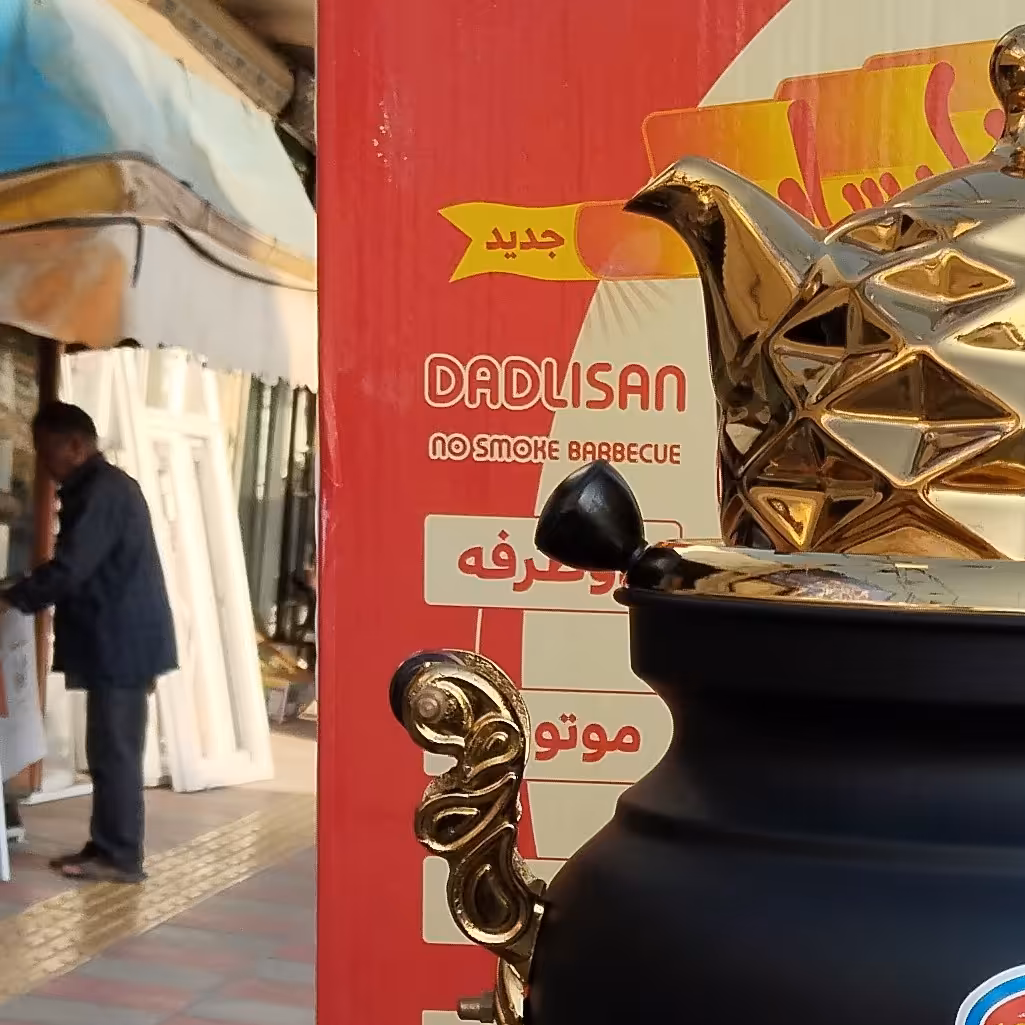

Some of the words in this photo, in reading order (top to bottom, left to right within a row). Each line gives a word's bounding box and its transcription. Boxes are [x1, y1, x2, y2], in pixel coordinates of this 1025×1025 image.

[486, 227, 565, 259] جدید
[425, 353, 688, 412] DADLISAN
[472, 434, 560, 464] SMOKE
[568, 440, 681, 465] BARBECUE
[458, 529, 628, 595] وطرفه
[534, 712, 642, 762] موتو
